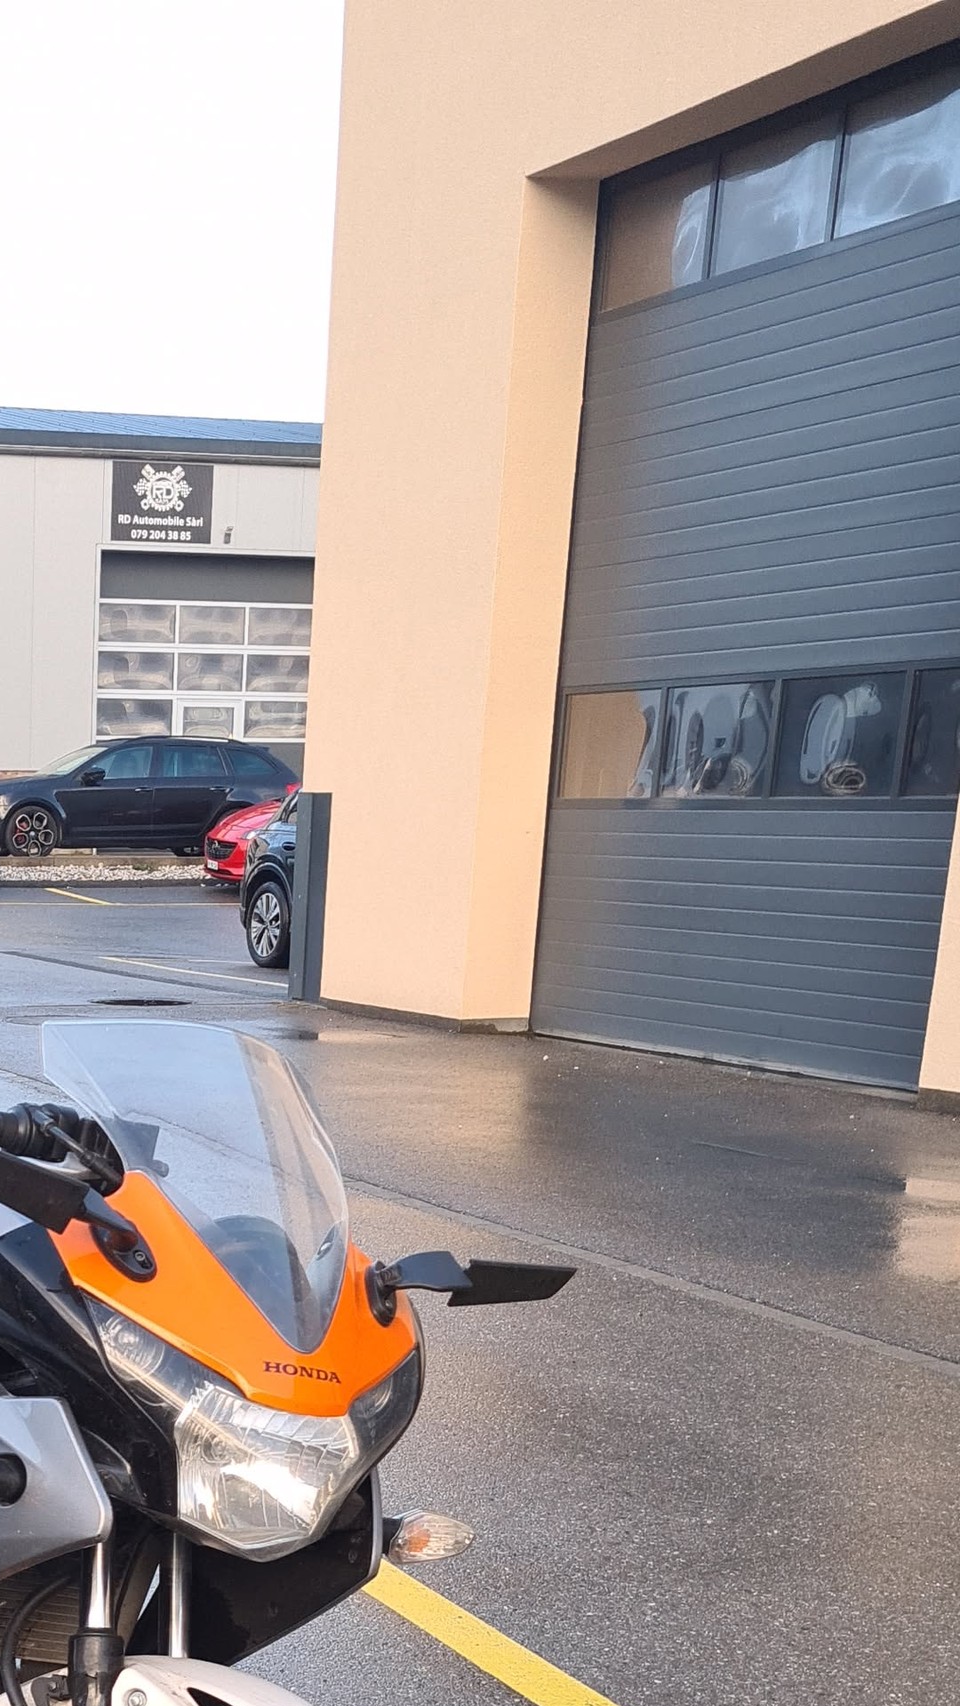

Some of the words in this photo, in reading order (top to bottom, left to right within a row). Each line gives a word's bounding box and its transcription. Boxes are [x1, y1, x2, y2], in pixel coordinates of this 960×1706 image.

[118, 514, 131, 524] RD
[132, 515, 185, 527] Automobile
[186, 517, 203, 527] Sàrl
[131, 529, 148, 539] 079
[149, 530, 166, 540] 204
[167, 531, 178, 540] 38
[180, 531, 191, 541] 85
[263, 1361, 342, 1384] HONDA
